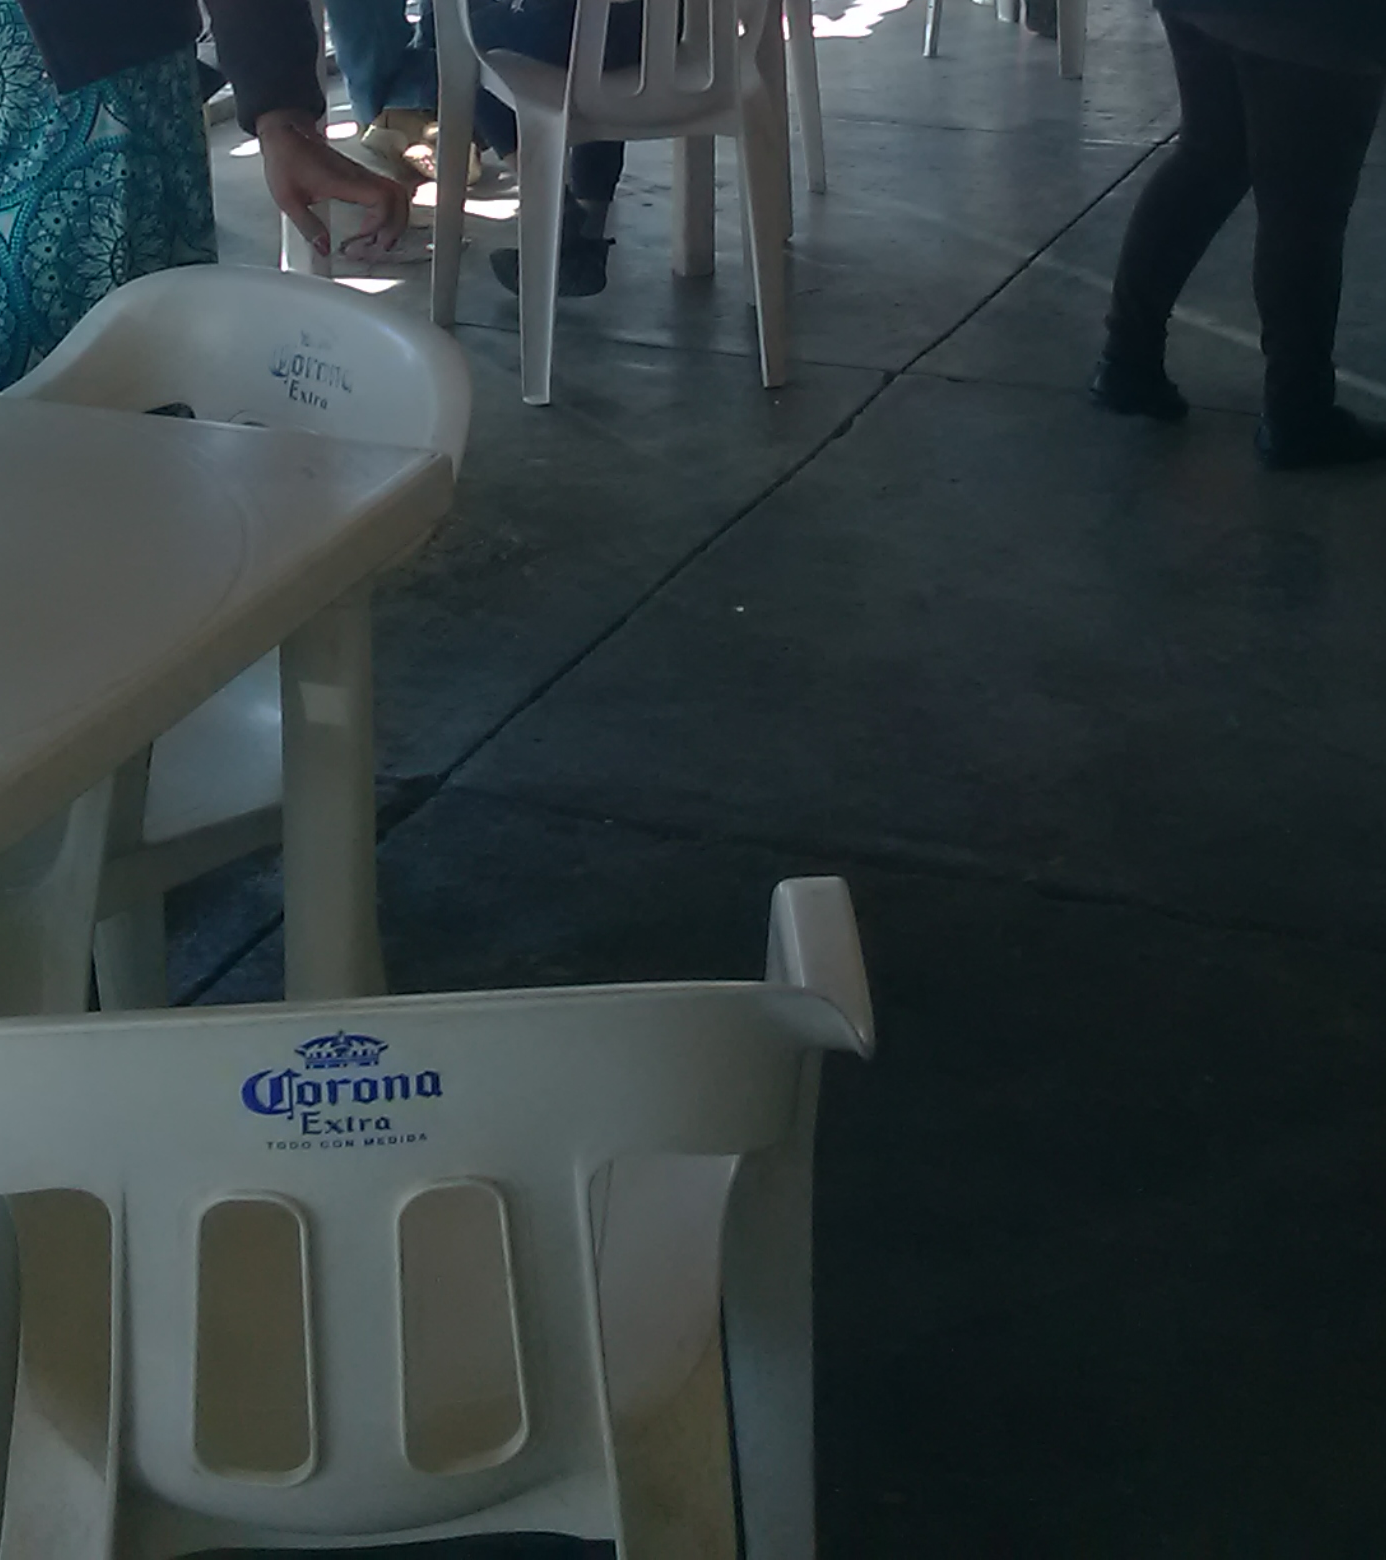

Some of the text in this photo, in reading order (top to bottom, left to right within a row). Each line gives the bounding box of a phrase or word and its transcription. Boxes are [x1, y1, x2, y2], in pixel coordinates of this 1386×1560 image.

[288, 379, 328, 409] Extra
[241, 1068, 443, 1120] Corona
[300, 1111, 391, 1135] Extra
[266, 1133, 428, 1151] TODO CON MEDIDA
